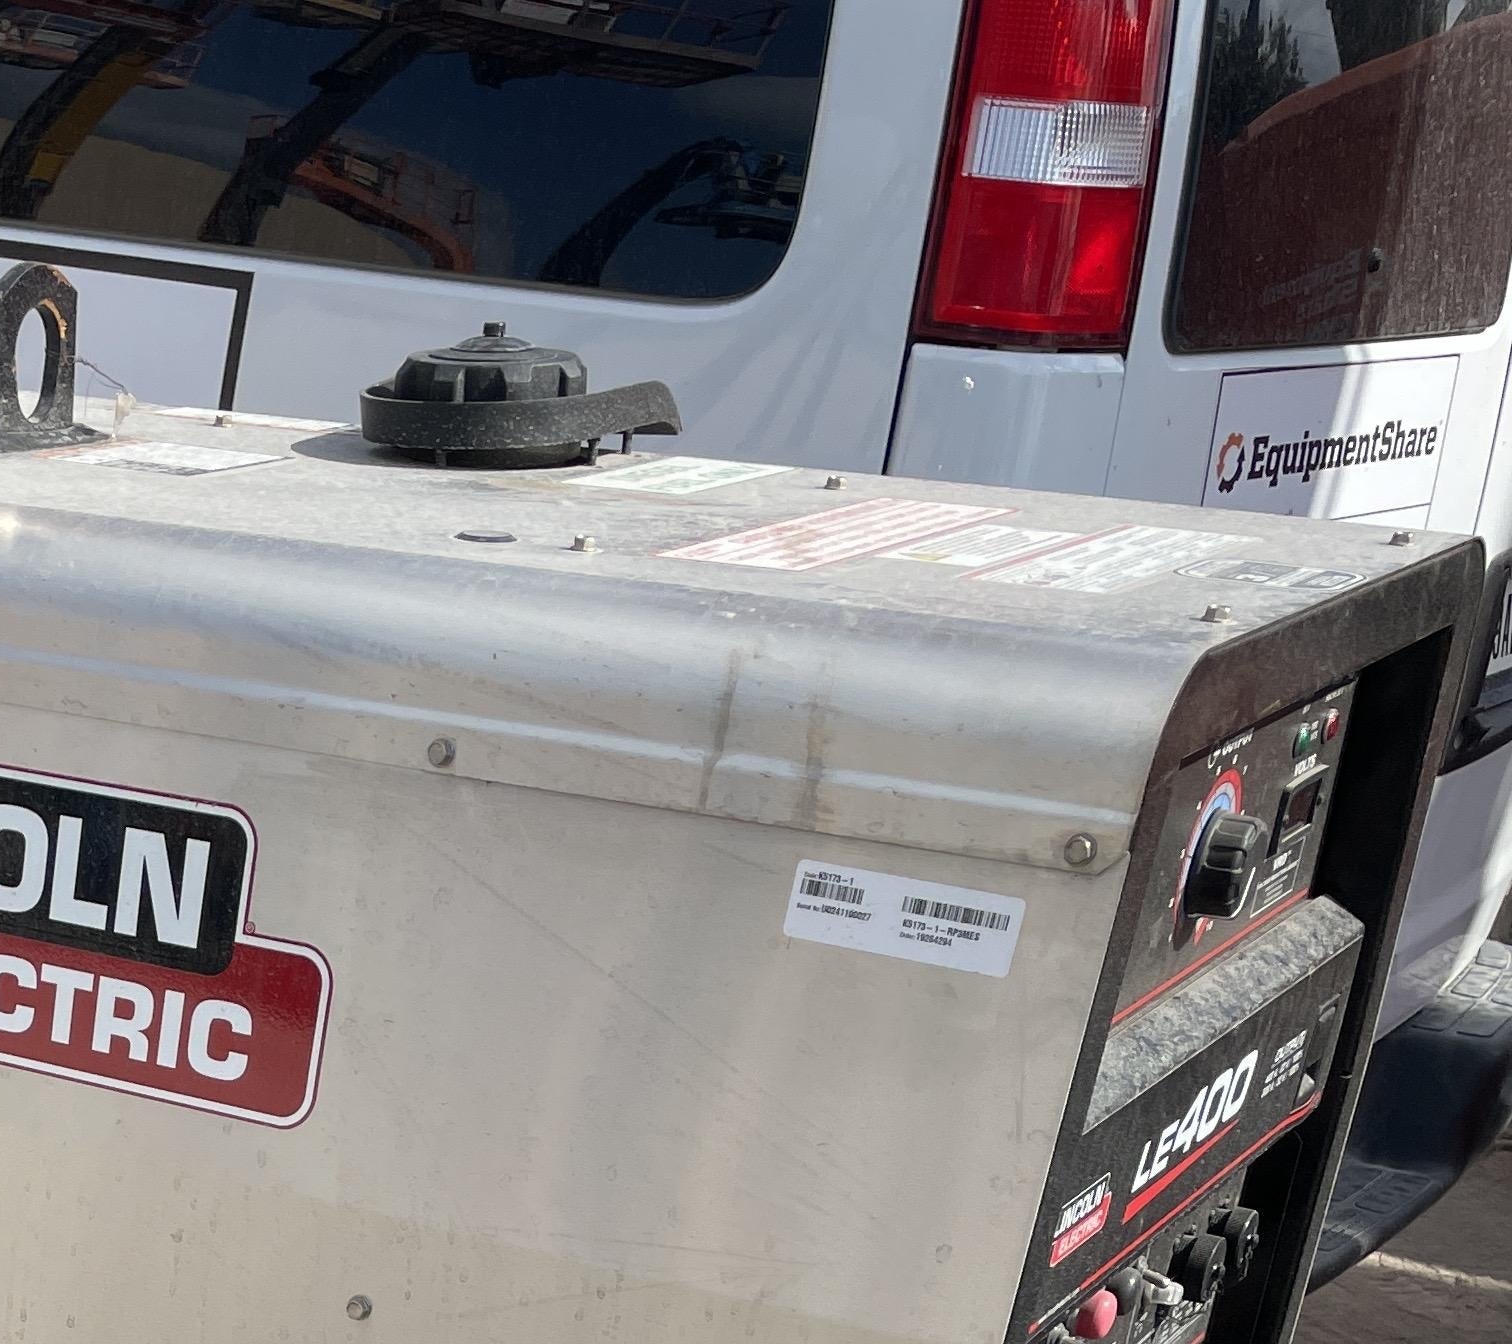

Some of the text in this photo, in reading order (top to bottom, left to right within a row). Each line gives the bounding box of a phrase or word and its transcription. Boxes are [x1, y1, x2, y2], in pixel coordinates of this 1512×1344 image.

[1247, 420, 1437, 488] EquipmentShare
[1131, 1050, 1259, 1194] LE400
[1054, 1181, 1106, 1238] LINCOLN
